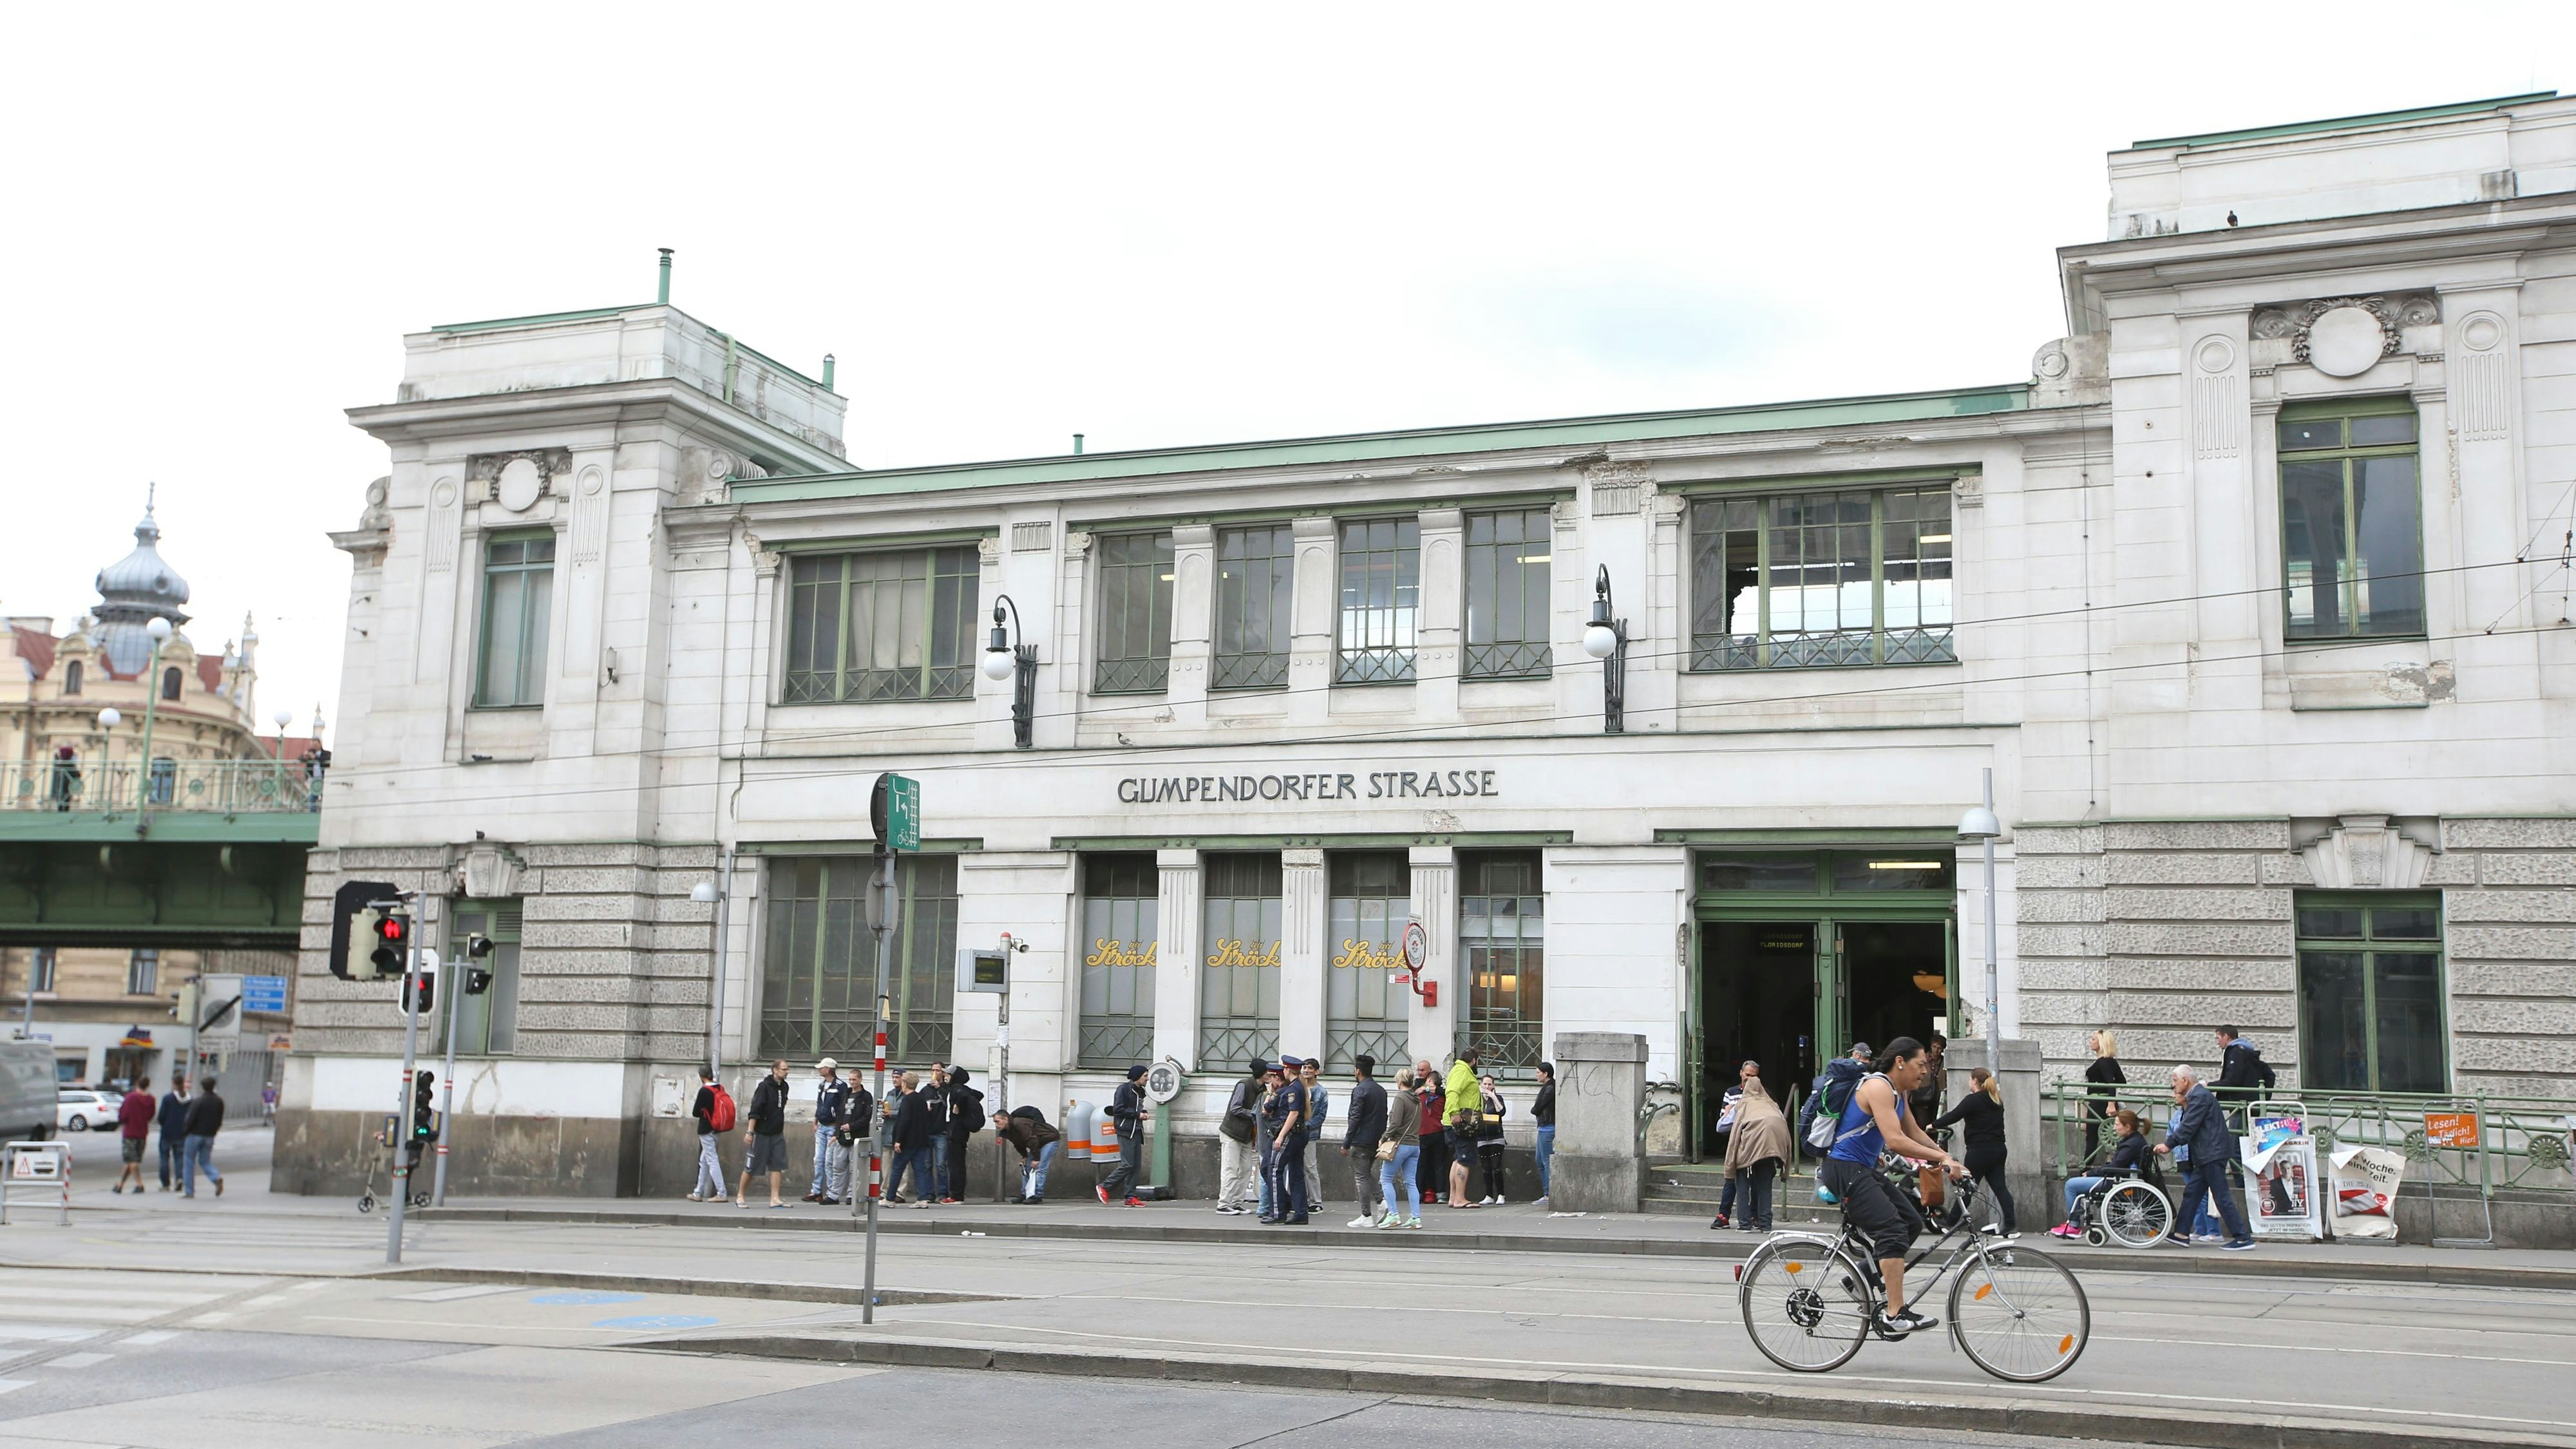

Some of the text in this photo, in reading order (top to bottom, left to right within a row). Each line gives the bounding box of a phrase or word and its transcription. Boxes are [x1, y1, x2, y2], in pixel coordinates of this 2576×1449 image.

[1117, 770, 1499, 803] GUMPENDORFER STRASSE
[1086, 937, 1157, 967] Ströck
[1206, 938, 1282, 967] Ströck
[1332, 938, 1409, 969] Ströck
[2428, 1115, 2459, 1130] Lesen!
[2459, 1135, 2476, 1144] Hier!
[2347, 1160, 2367, 1173] eine
[2362, 1155, 2396, 1175] Woche.
